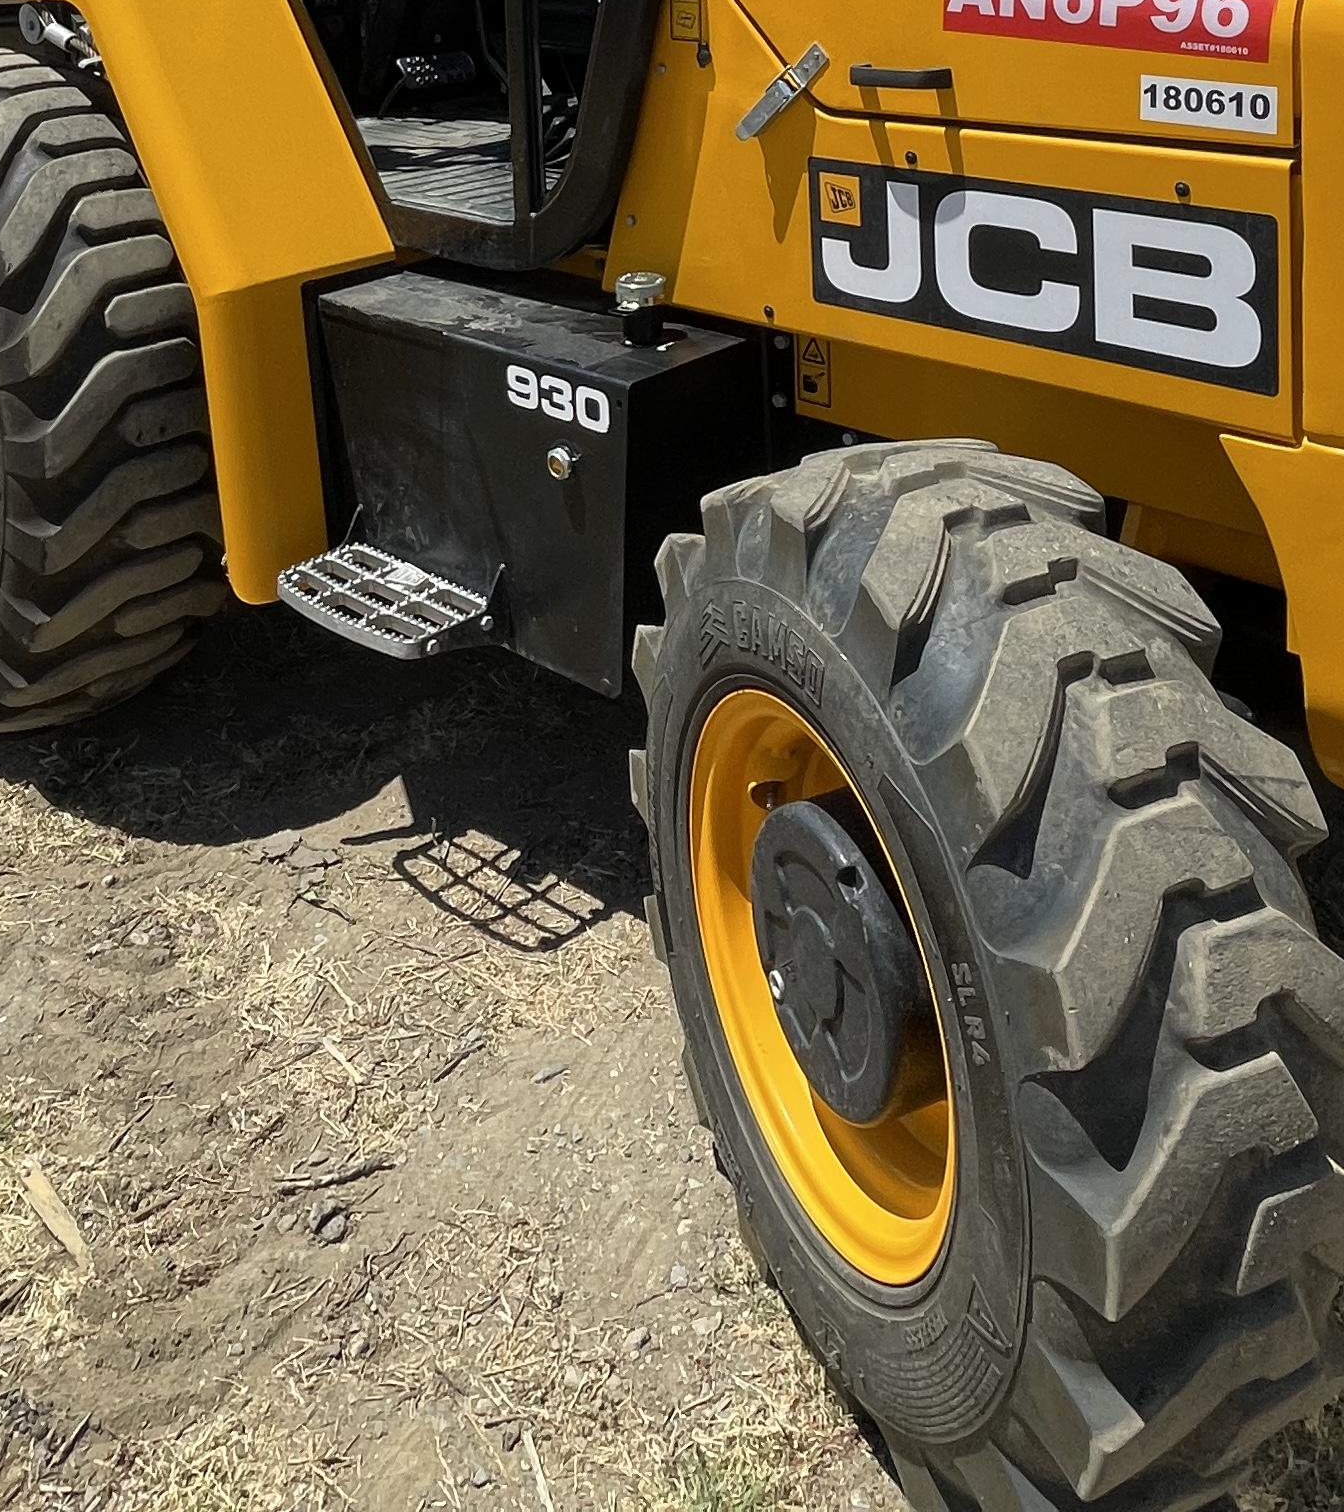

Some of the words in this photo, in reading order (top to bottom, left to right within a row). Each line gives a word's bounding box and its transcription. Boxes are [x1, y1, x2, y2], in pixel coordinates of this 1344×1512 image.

[1143, 83, 1271, 120] 180610
[830, 185, 855, 210] JCB
[820, 180, 1263, 369] JCB
[506, 364, 611, 434] 930
